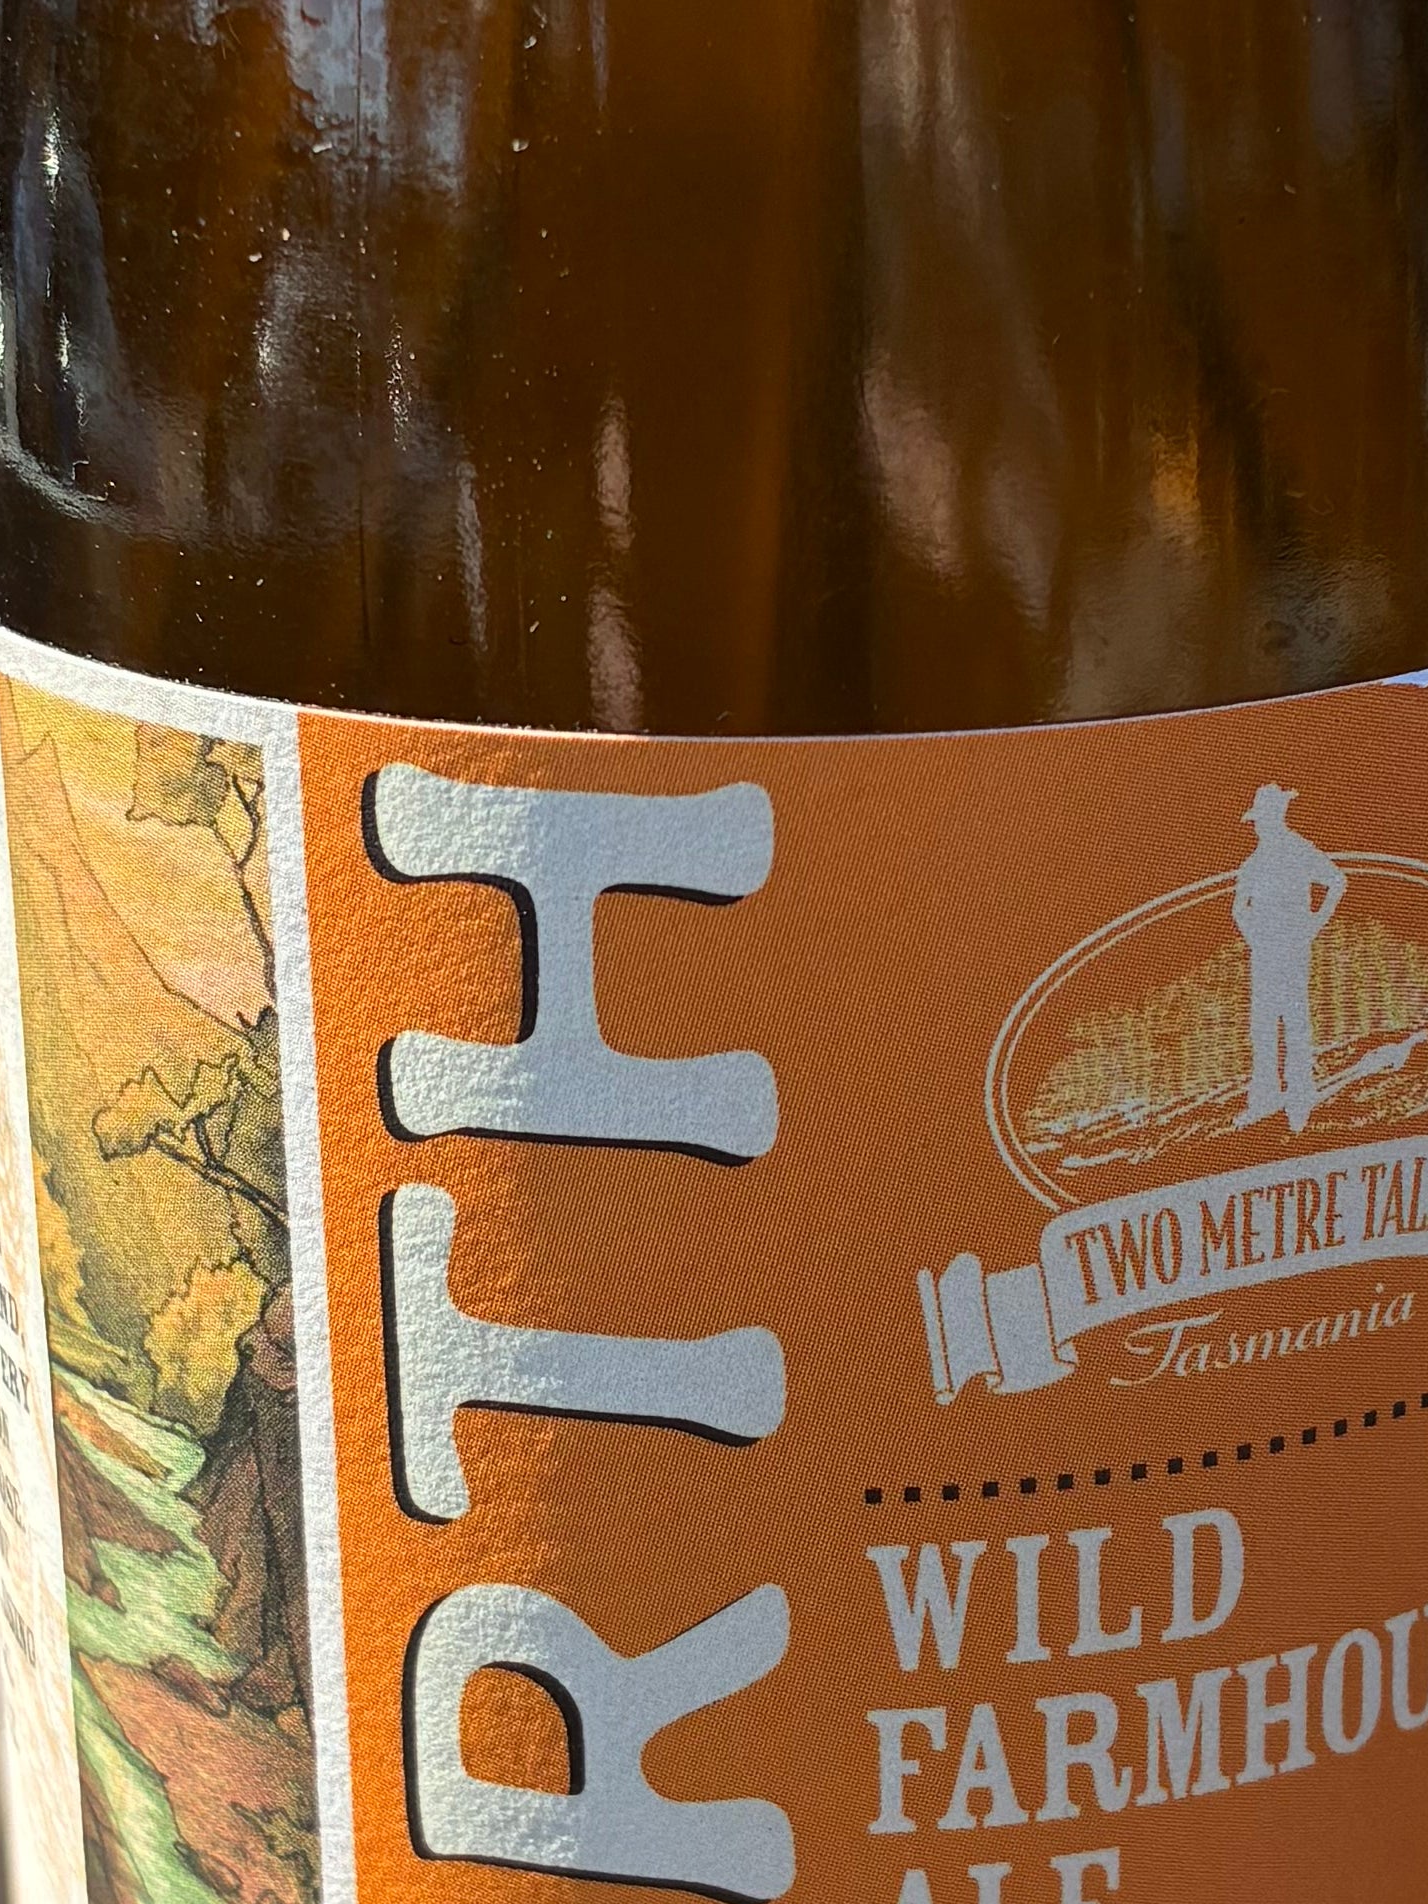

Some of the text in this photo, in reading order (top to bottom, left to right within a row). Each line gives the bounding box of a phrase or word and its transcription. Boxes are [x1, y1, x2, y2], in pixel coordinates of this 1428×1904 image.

[1064, 1207, 1183, 1306] TWO
[1199, 1163, 1347, 1276] METRE
[1109, 1283, 1419, 1389] Tasmania
[866, 1507, 1246, 1673] WILD
